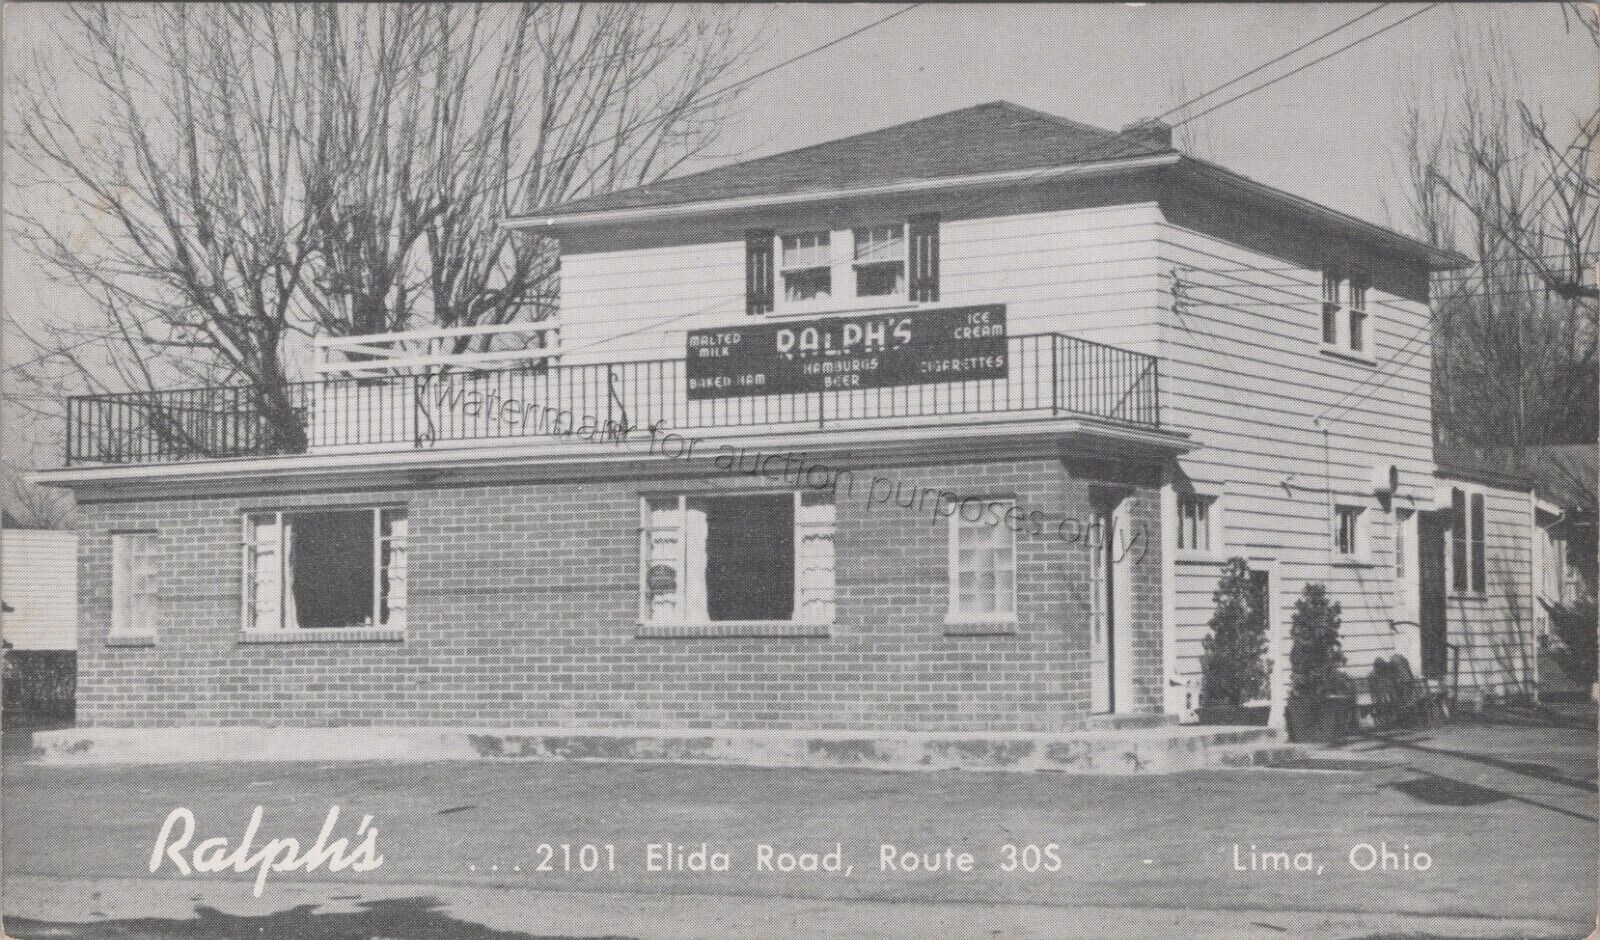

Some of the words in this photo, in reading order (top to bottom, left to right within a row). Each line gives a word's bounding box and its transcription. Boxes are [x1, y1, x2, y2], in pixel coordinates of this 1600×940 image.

[967, 310, 991, 325] ICE
[776, 317, 912, 360] RALPH'S
[953, 324, 1004, 339] CREAM
[689, 332, 741, 348] MALTED
[699, 346, 730, 358] MILK
[921, 355, 1004, 373] CIGARETTES
[824, 373, 860, 388] BEER
